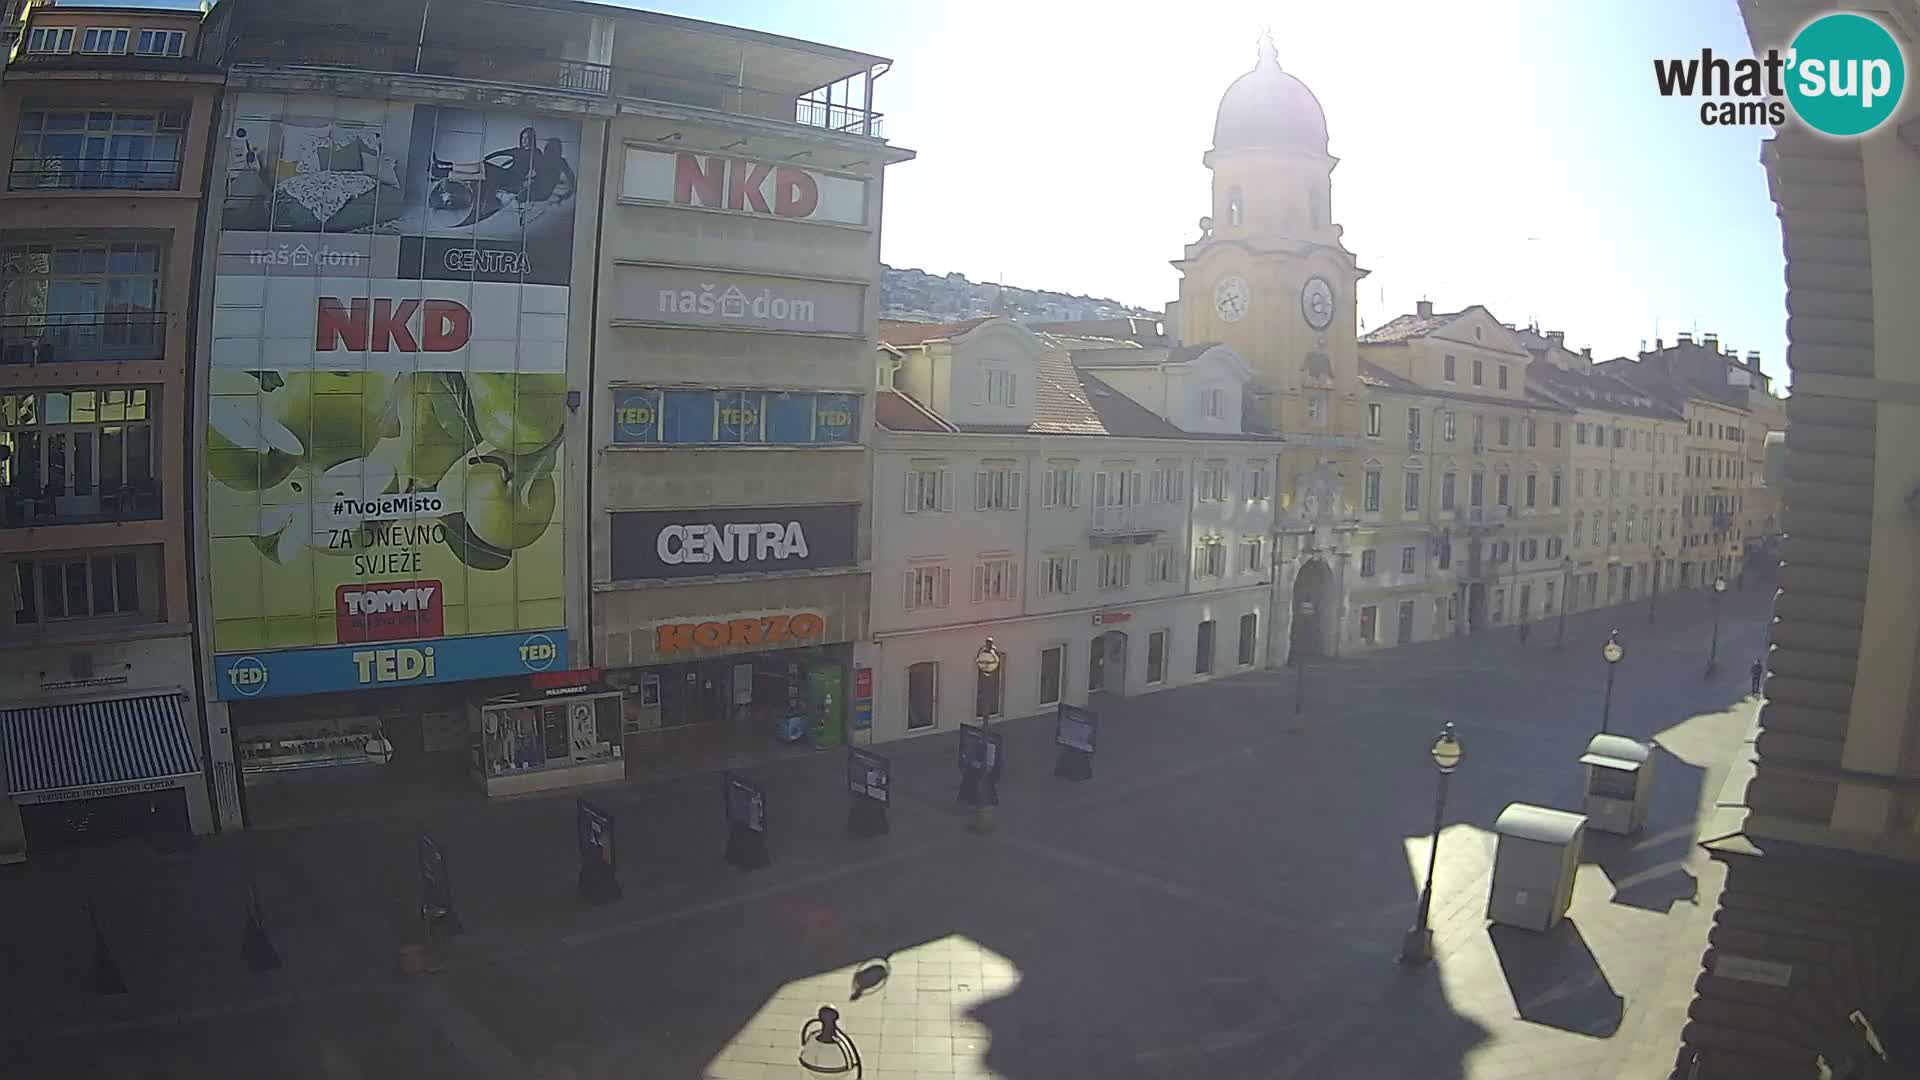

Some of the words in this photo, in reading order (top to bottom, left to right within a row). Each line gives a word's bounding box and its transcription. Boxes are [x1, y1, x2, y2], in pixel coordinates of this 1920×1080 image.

[674, 152, 818, 218] NKD
[249, 244, 289, 265] naš
[314, 245, 360, 266] dom
[444, 248, 531, 274] CENTRA
[658, 283, 715, 315] naš
[752, 289, 815, 322] dom
[316, 297, 472, 352] NKD
[616, 408, 655, 425] TEDi
[720, 409, 758, 425] TEDi
[816, 410, 852, 426] TEDi
[333, 496, 442, 516] #TvojeMisto
[328, 529, 353, 549] ZA
[361, 524, 446, 548] DNEVNO
[657, 521, 808, 564] CENTRA
[354, 548, 422, 575] SVJEŽE
[344, 587, 435, 615] TOMMY
[656, 613, 824, 653] KORZO
[353, 646, 435, 683] TEDi
[518, 644, 556, 661] TEDi
[228, 667, 268, 685] TEDi
